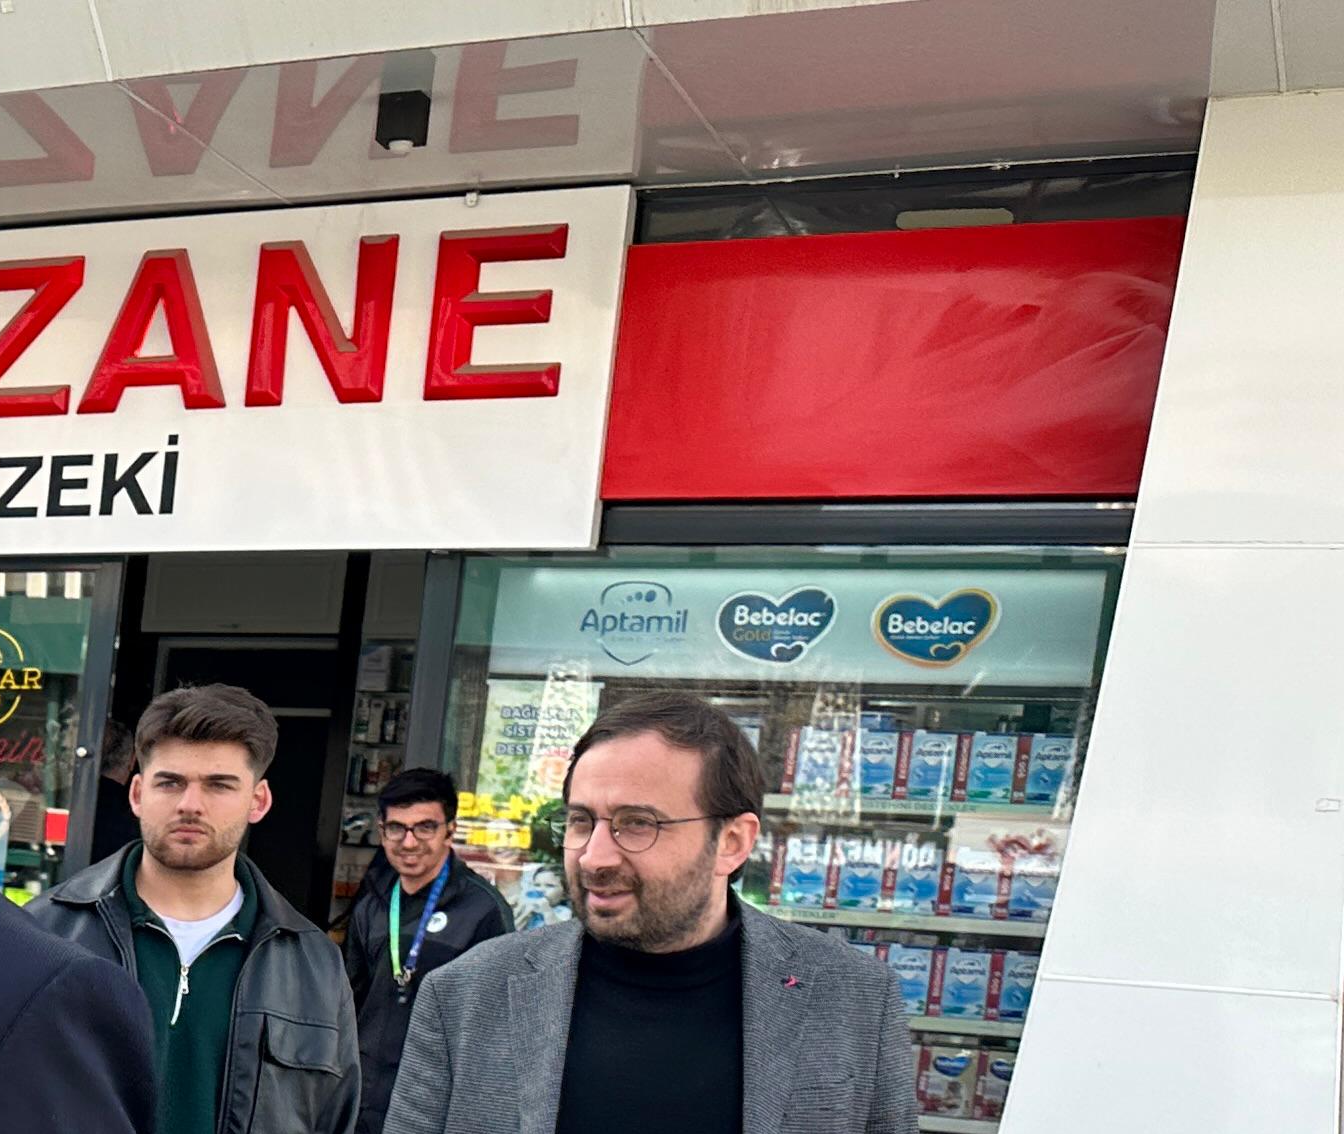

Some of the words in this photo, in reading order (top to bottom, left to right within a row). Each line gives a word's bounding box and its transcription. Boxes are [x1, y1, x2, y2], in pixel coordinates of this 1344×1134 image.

[579, 608, 689, 637] Aptamil
[734, 604, 822, 626] Bebelac
[887, 613, 977, 635] Bebelac
